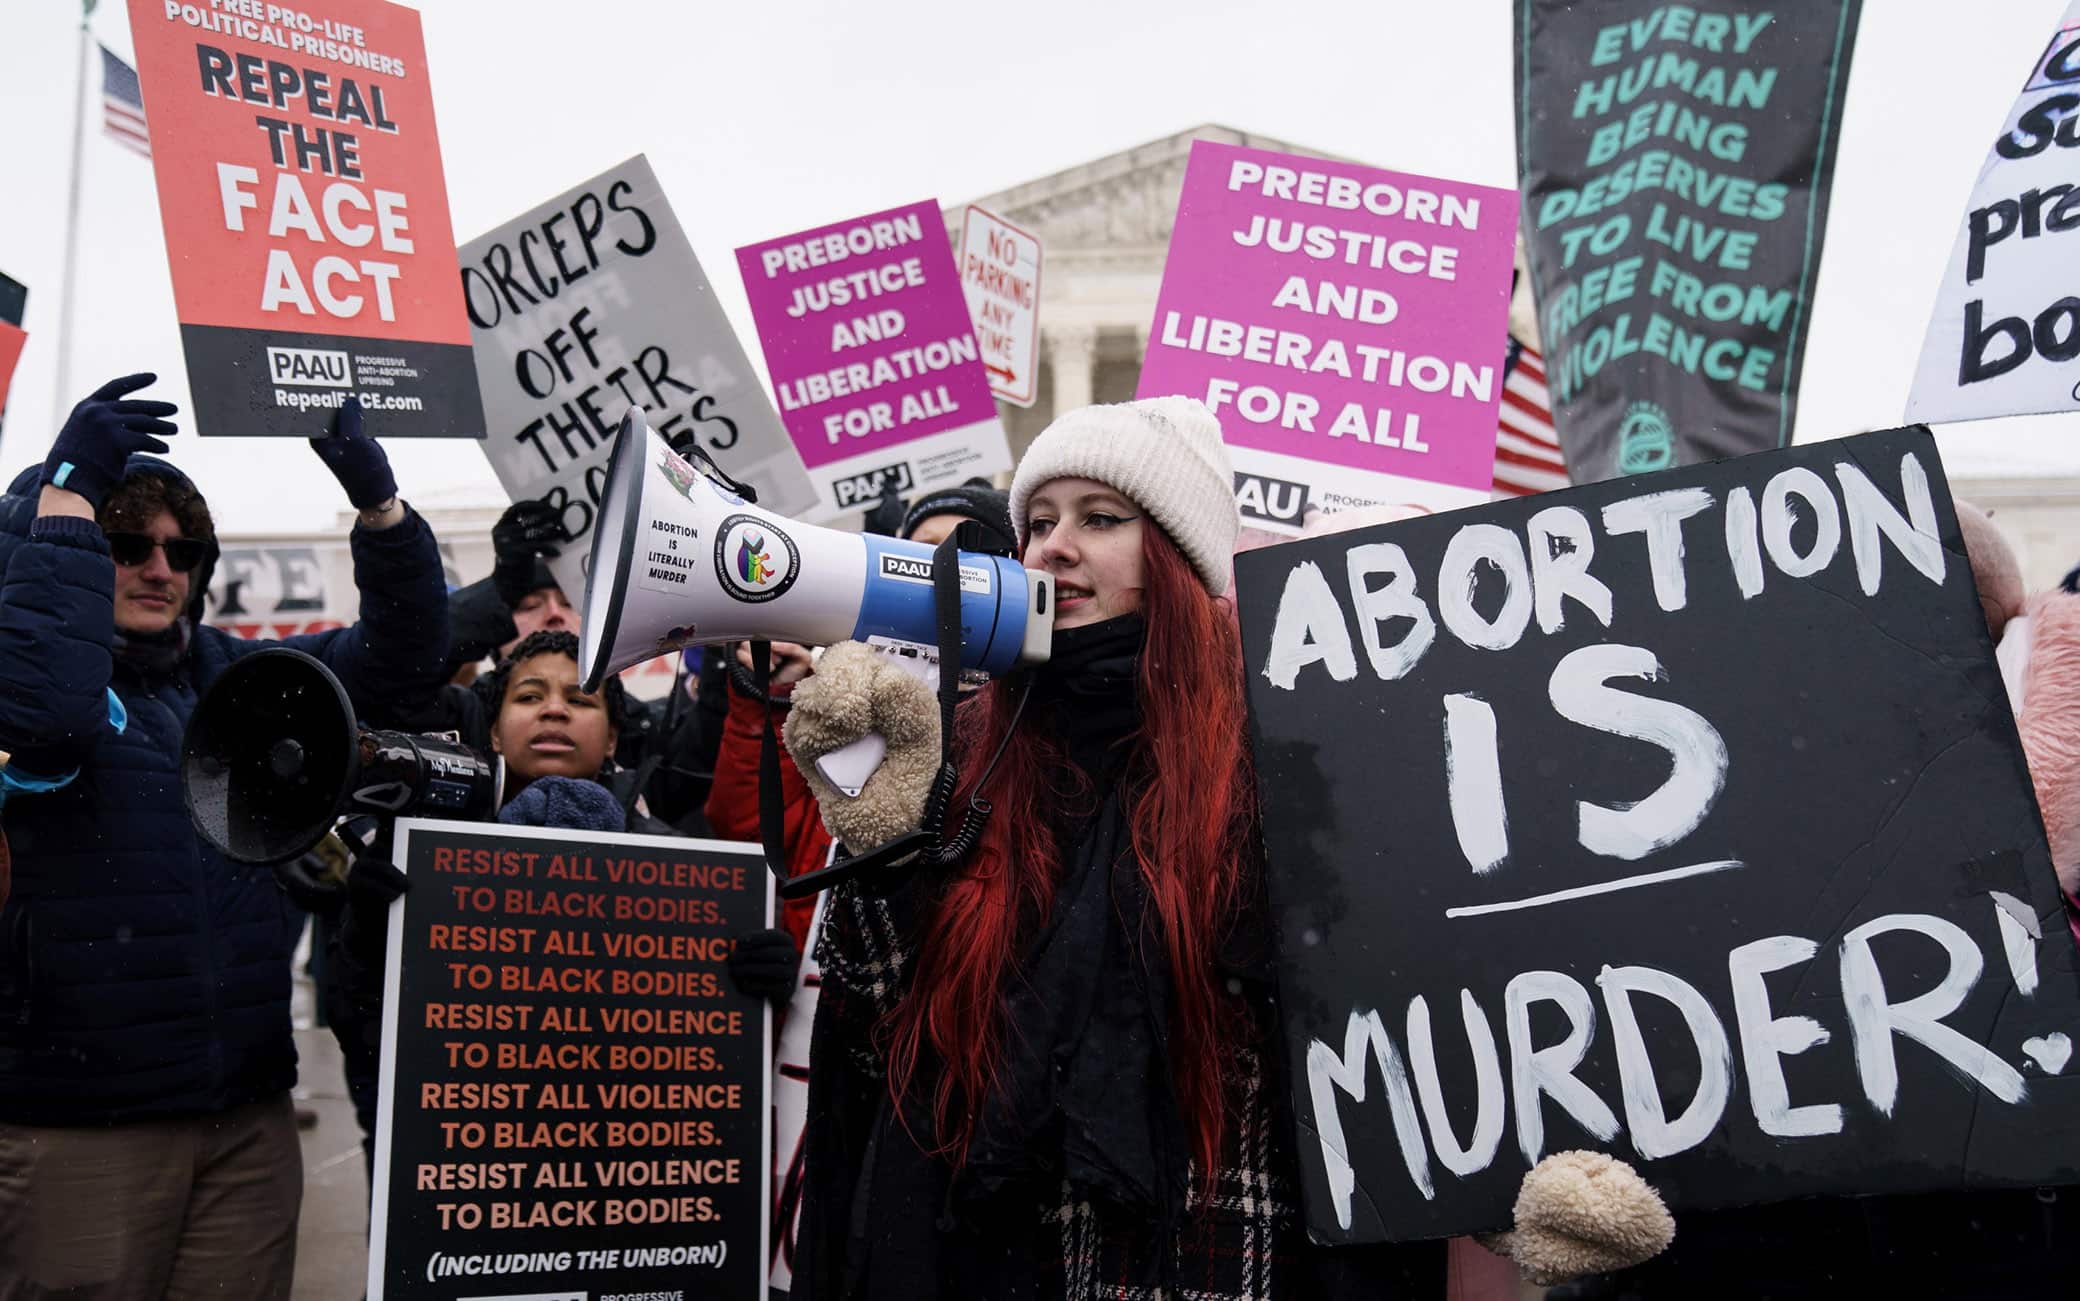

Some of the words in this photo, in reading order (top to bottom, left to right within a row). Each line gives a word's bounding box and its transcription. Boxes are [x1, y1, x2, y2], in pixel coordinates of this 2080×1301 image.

[164, 0, 290, 50] POLITICAL
[290, 32, 407, 78] PRISONERS
[267, 4, 366, 48] PRO-LIFE
[1590, 4, 1775, 67] EVERY
[196, 43, 400, 135] REPEAL
[1571, 51, 1778, 119] HUMAN
[255, 115, 364, 181] THE
[1585, 100, 1750, 168] BEING
[216, 161, 415, 255] FACE
[1227, 159, 1481, 231] PREBORN
[1537, 149, 1790, 230] DESERVES
[460, 180, 657, 329] ORCEPS
[761, 213, 923, 279] PREBORN
[987, 228, 1017, 266] NO
[1232, 215, 1460, 282] JUSTICE
[1559, 213, 1632, 269] TO
[1644, 202, 1760, 271] LIVE
[260, 248, 402, 322] ACT
[786, 258, 927, 318] JUSTICE
[966, 253, 1033, 310] PARKING
[1271, 276, 1399, 325] AND
[1549, 255, 1645, 351] FREE
[1648, 258, 1793, 333] FROM
[831, 309, 906, 352] AND
[977, 324, 1016, 361] TIME
[981, 298, 1016, 330] ANY
[273, 352, 345, 381] PAAU
[354, 355, 407, 367] PROGRESSIVE
[357, 365, 418, 378] ANTI-ABORTION
[515, 306, 600, 400] OFF
[778, 333, 979, 411] LIBERATION
[1160, 310, 1494, 403] LIBERATION
[1559, 311, 1776, 405] VIOLENCE
[274, 389, 423, 413] RepealFCE.com
[515, 346, 700, 473] THEIR
[823, 402, 895, 445] FOR
[900, 386, 960, 425] ALL
[1204, 377, 1320, 433] FOR
[1327, 403, 1431, 454] ALL
[1235, 477, 1302, 520] AU
[651, 519, 698, 539] ABORTION
[668, 539, 678, 550] IS
[217, 548, 324, 615] FE
[648, 551, 695, 570] LITERALLY
[648, 567, 687, 585] MURDER
[887, 559, 931, 578] PAAU
[1261, 450, 1947, 691] ABORTION
[1441, 643, 1730, 874] IS
[434, 847, 540, 877] RESIST
[547, 855, 598, 882] ALL
[605, 859, 746, 891] VIOLENCE
[452, 886, 497, 912] TO
[504, 889, 606, 919] BLACK
[614, 896, 728, 925] BODIES.
[429, 924, 536, 953] RESIST
[544, 930, 596, 957] ALL
[603, 933, 737, 962] VIOLENC
[448, 963, 493, 989] TO
[501, 965, 604, 993] BLACK
[612, 971, 725, 998] BODIES.
[425, 1003, 533, 1030] RESIST
[540, 1007, 593, 1032] ALL
[600, 1010, 743, 1036] VIOLENCE
[445, 1042, 489, 1070] TO
[497, 1043, 601, 1070] BLACK
[609, 1045, 724, 1071] BODIES.
[1306, 890, 2073, 1230] MURDER!
[420, 1082, 530, 1110] RESIST
[536, 1083, 590, 1110] ALL
[598, 1084, 742, 1110] VIOLENCE
[440, 1121, 486, 1150] TO
[494, 1122, 599, 1149] BLACK
[607, 1121, 723, 1148] BODIES.
[416, 1162, 528, 1192] RESIST
[534, 1162, 588, 1189] ALL
[595, 1159, 741, 1188] VIOLENCE
[437, 1202, 483, 1231] TO
[490, 1200, 597, 1229] BLACK
[604, 1197, 721, 1226] BODIES.
[426, 1252, 572, 1283] (INCLUDING
[576, 1249, 619, 1270] THE
[622, 1240, 727, 1271] UNBORN)
